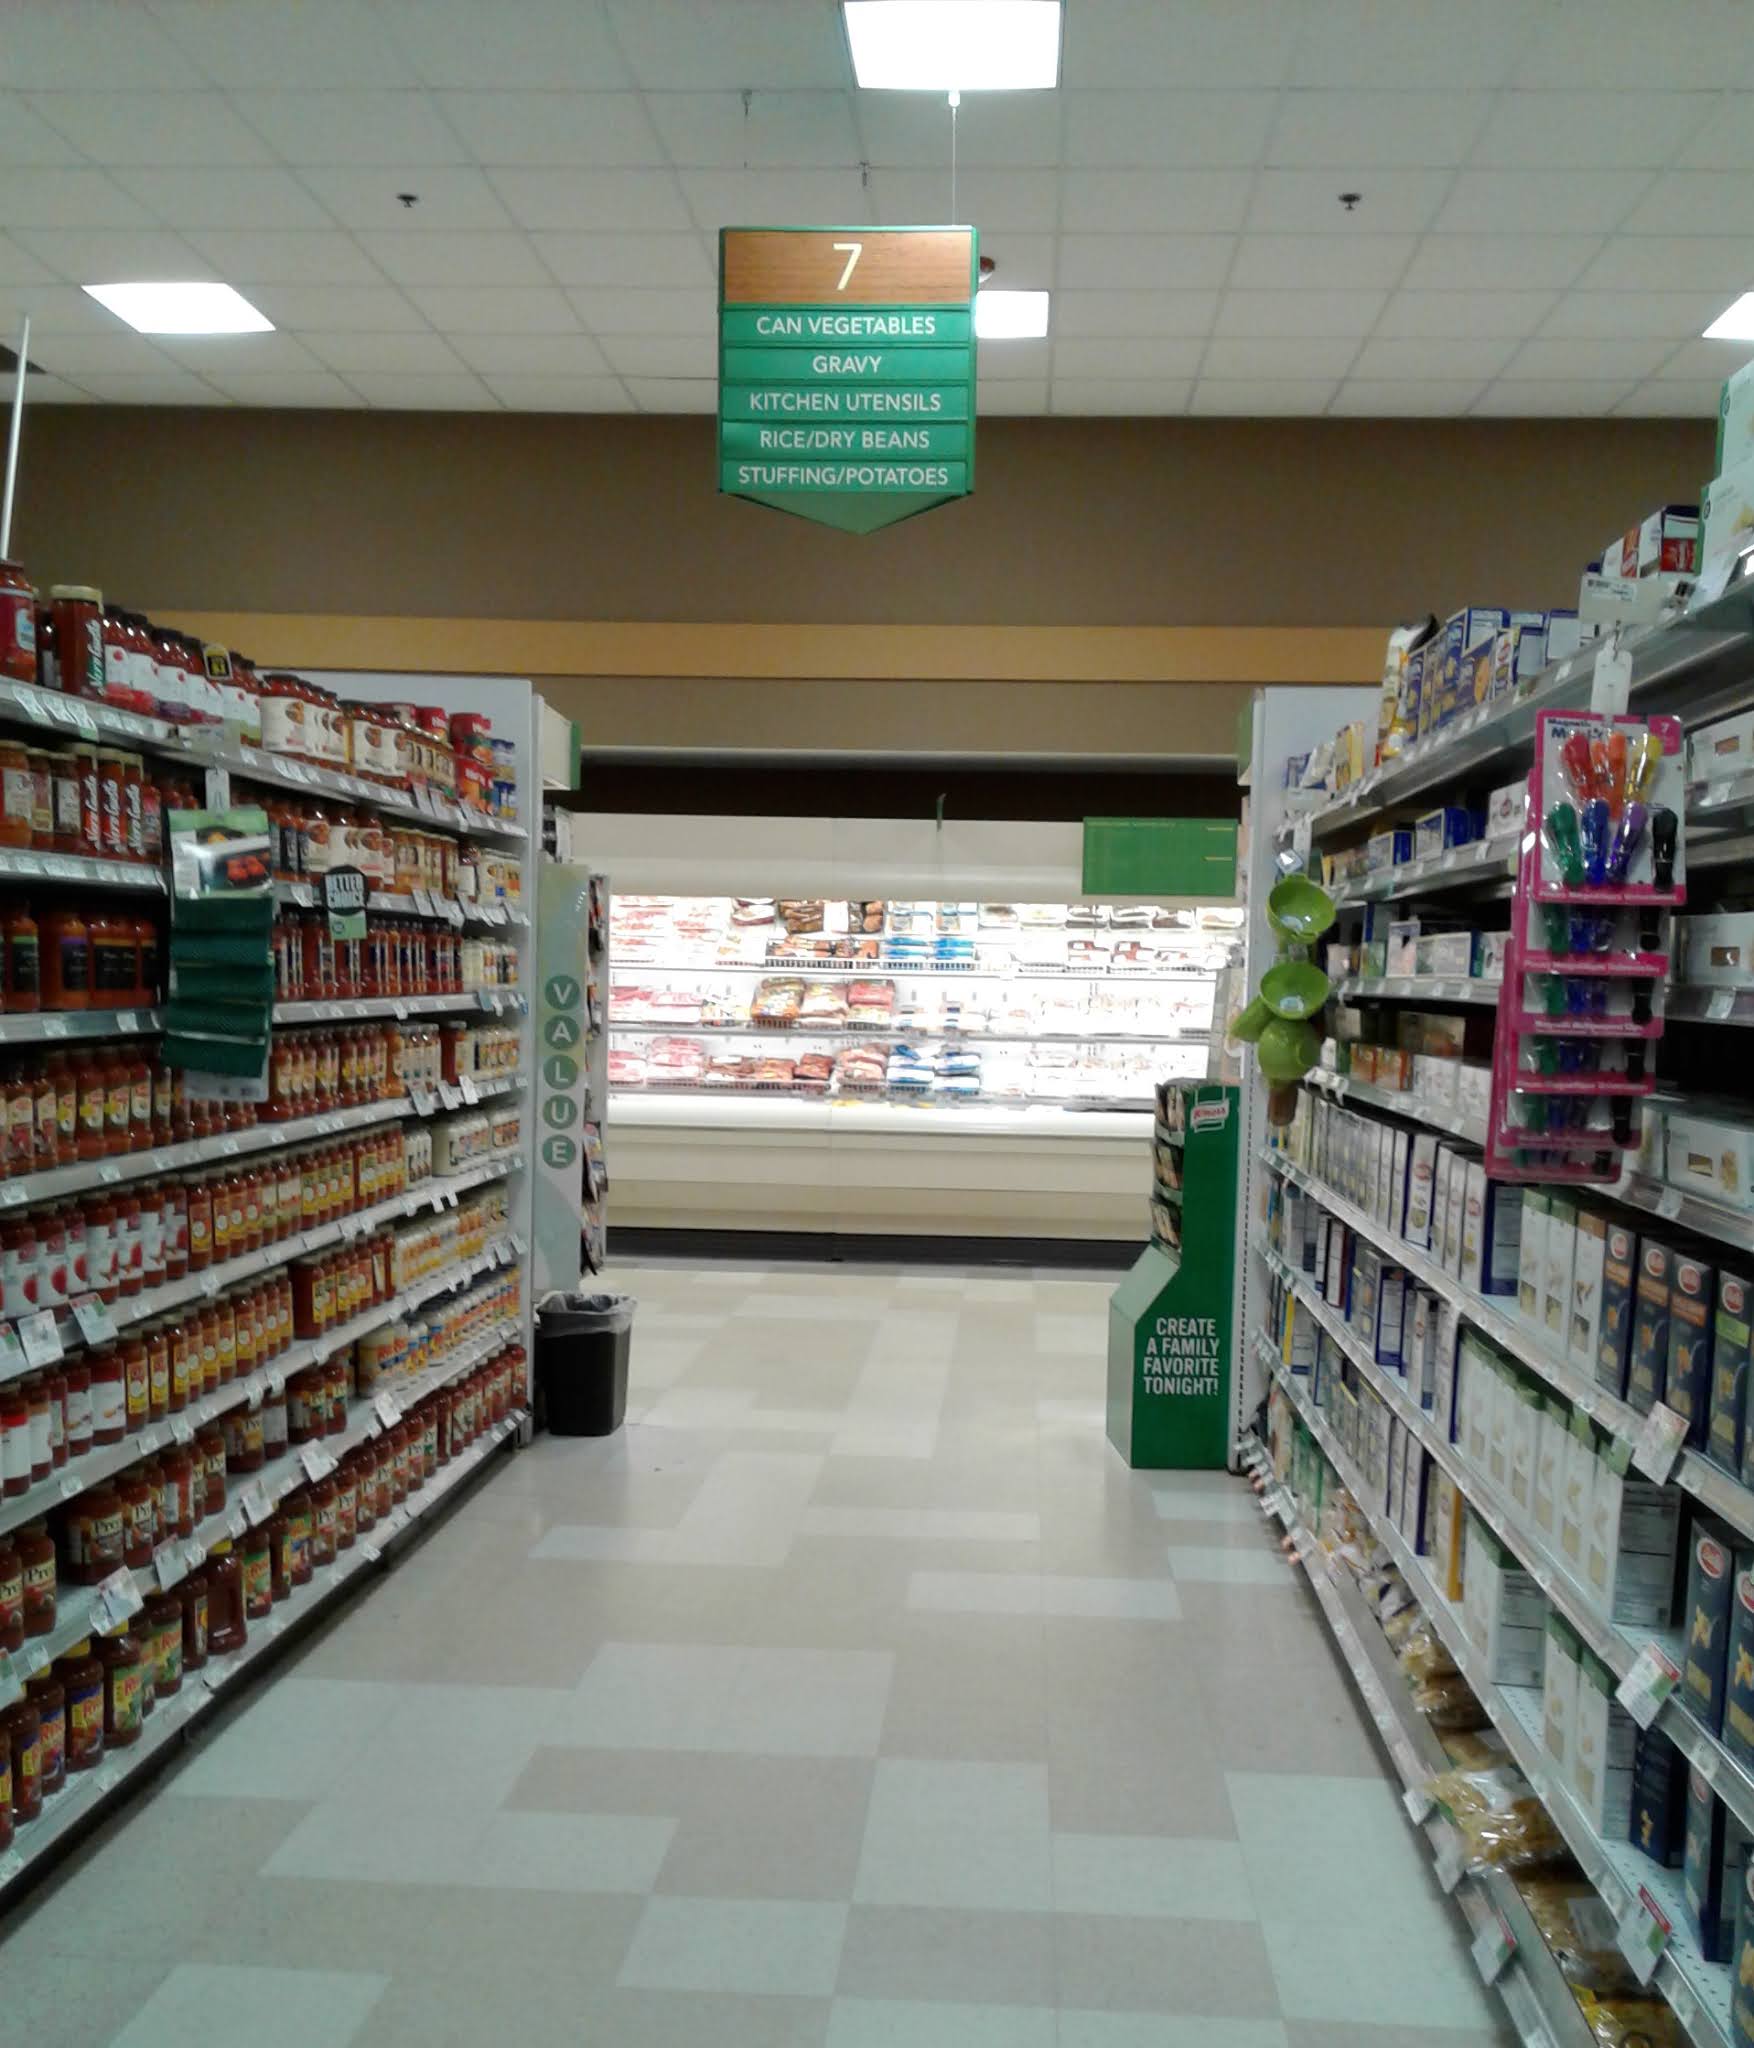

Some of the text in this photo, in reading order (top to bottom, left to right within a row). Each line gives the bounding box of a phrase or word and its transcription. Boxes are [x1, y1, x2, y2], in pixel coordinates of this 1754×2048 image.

[833, 243, 862, 291] 7
[756, 316, 936, 335] CAN VEGETABLES
[812, 355, 882, 374] GRAVY
[750, 392, 941, 412] KITCHEN UTENSILS
[759, 430, 930, 449] RICE/DRY BEANS
[738, 466, 949, 486] STUFFING/POTATOES
[551, 983, 573, 1163] VALUE
[1156, 1317, 1217, 1336] CREATE
[1146, 1337, 1220, 1356] A FAMILY
[1143, 1357, 1220, 1376] FAVORITE
[1143, 1376, 1219, 1396] TONIGHT!
